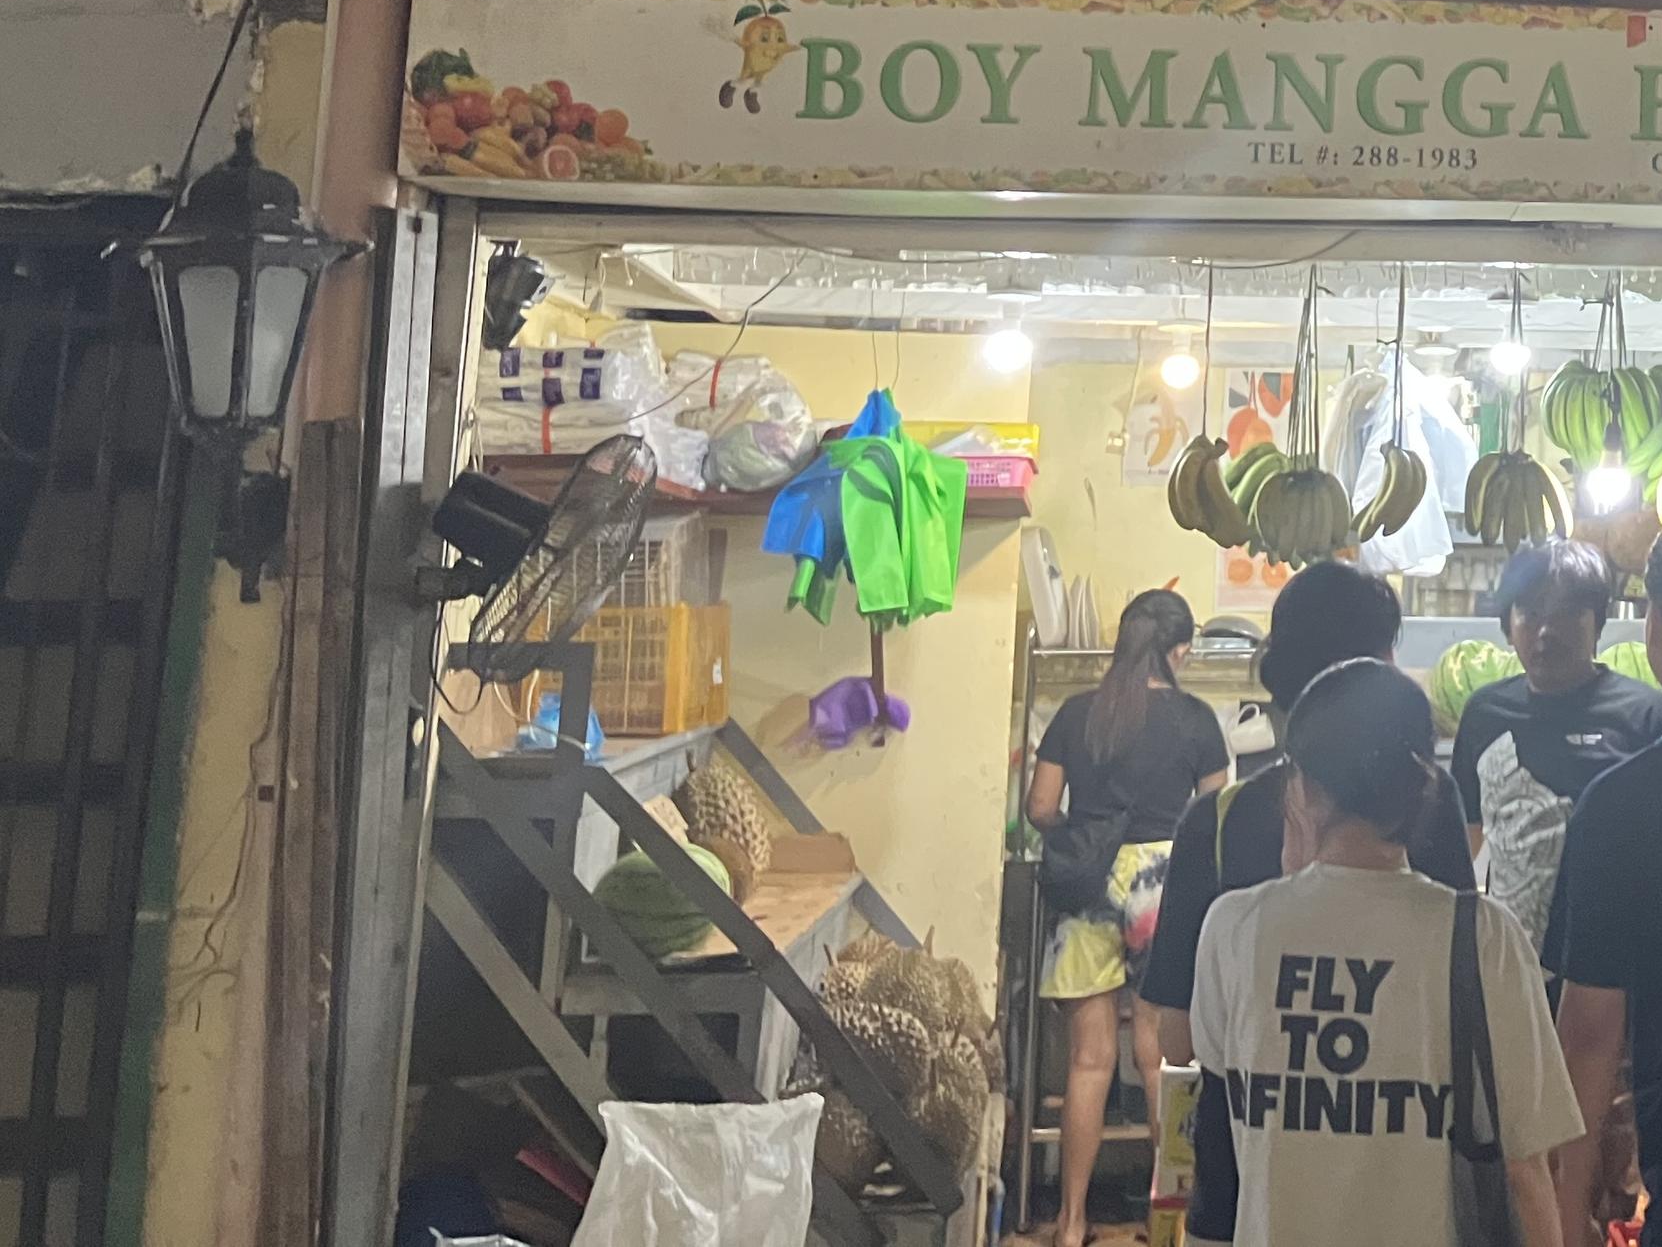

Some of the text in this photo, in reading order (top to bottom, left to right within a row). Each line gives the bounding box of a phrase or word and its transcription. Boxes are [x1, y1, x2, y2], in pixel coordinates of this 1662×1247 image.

[796, 37, 1042, 124] BOY
[1078, 46, 1591, 140] MANGGA
[1247, 141, 1479, 170] TEL #: 288-1983
[1275, 953, 1395, 1015] FLY
[1280, 1014, 1370, 1075] TO
[1225, 1068, 1453, 1140] NFINITY
